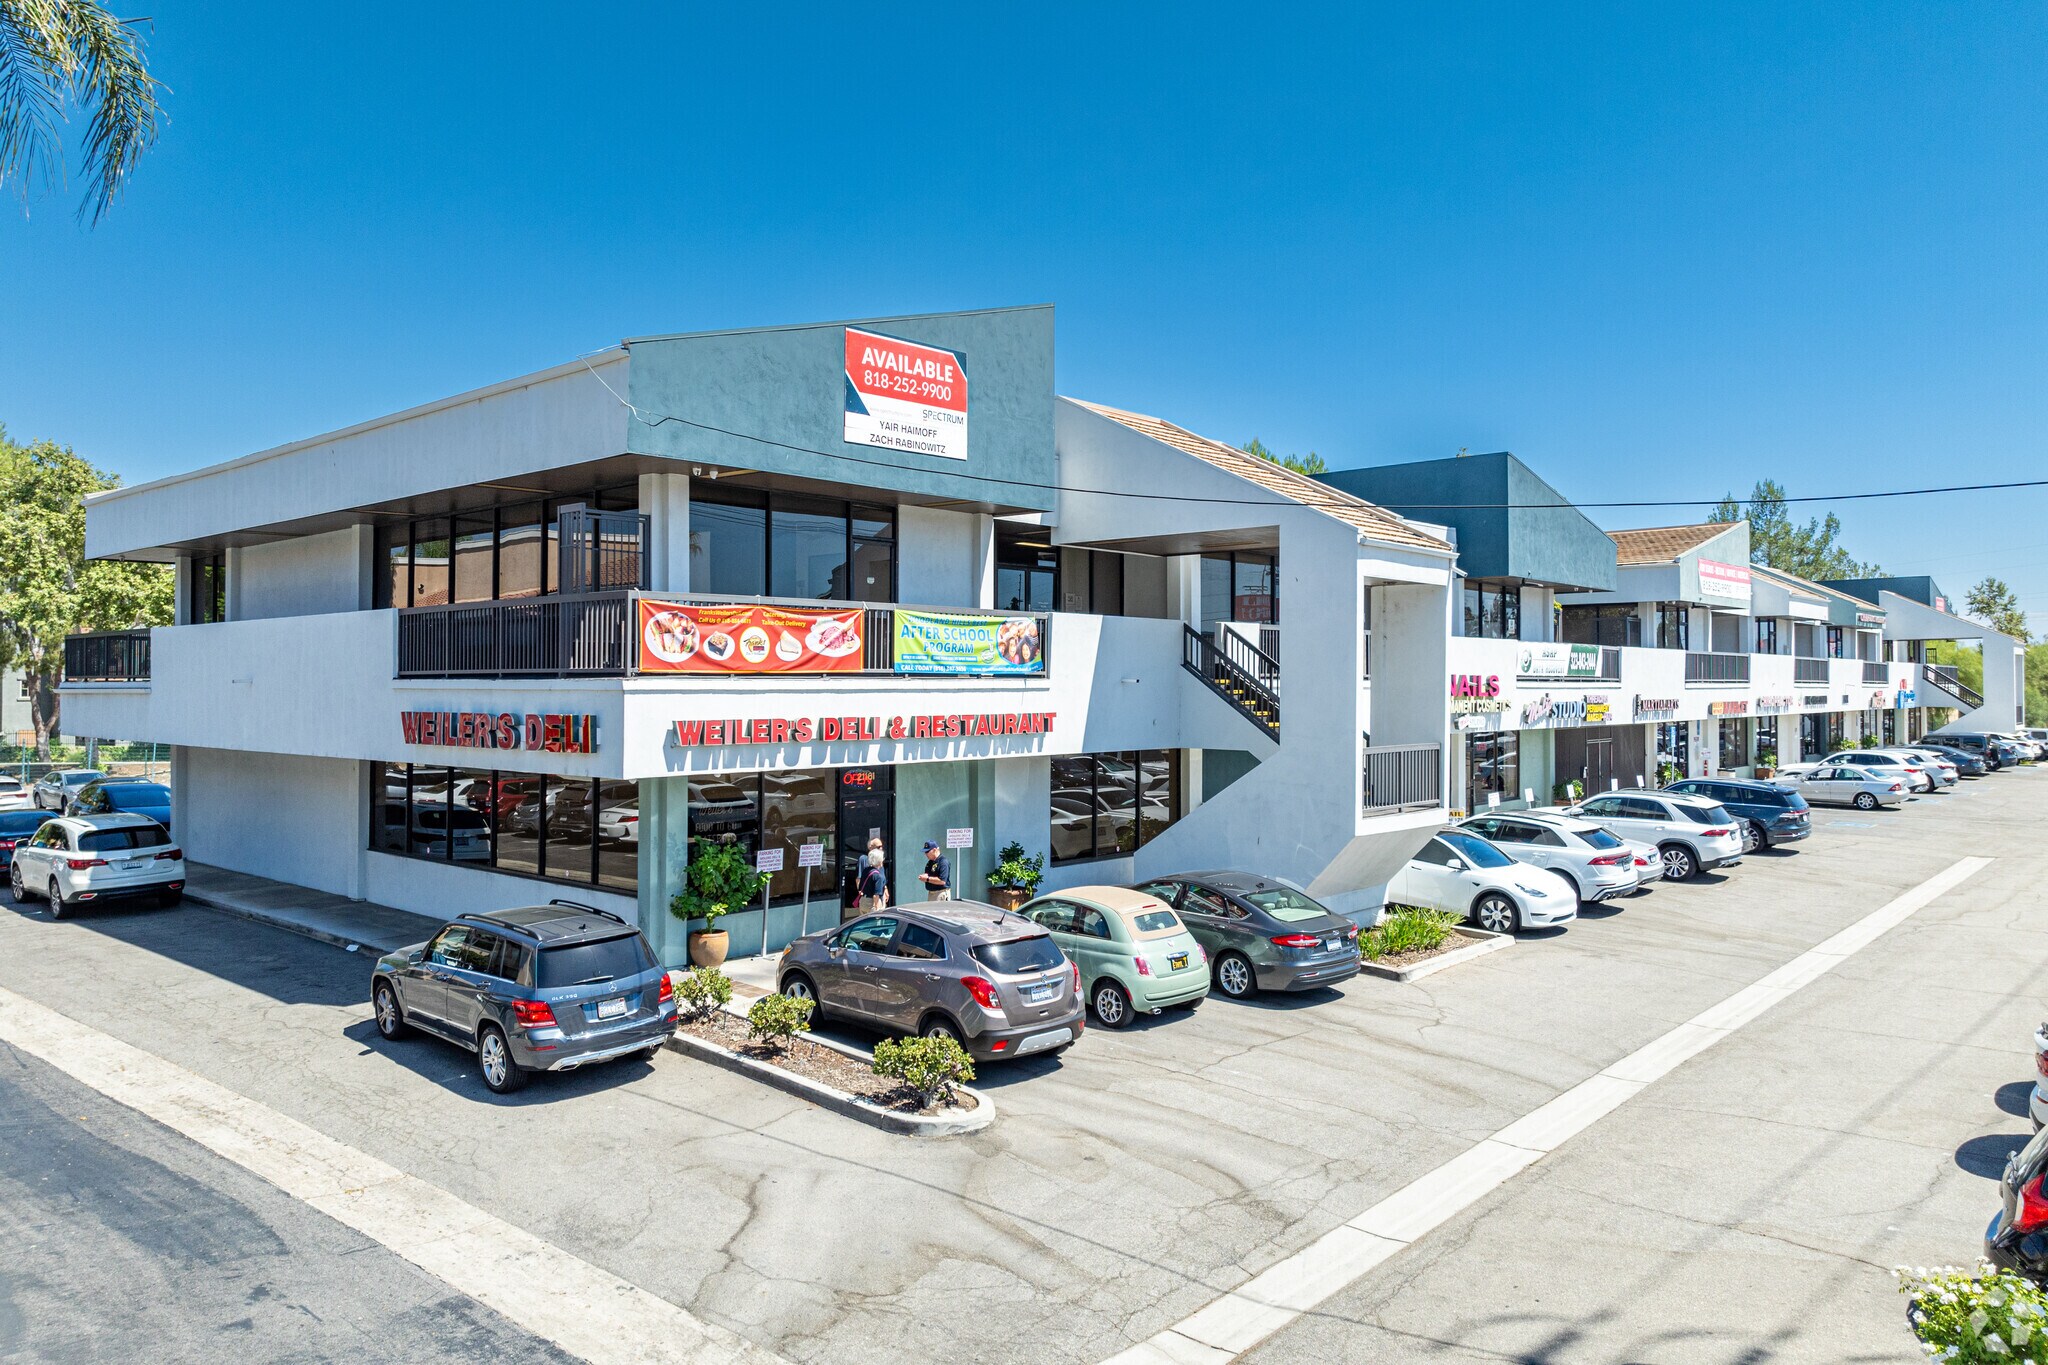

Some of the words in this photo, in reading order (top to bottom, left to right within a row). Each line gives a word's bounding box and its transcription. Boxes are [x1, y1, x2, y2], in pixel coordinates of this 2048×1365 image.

[861, 347, 953, 383] AVAILABLE
[864, 369, 951, 401] 818-252-9900
[923, 409, 963, 425] SPECTRUM
[880, 420, 898, 432] YAIR
[901, 424, 937, 438] HAIMOFF
[870, 433, 893, 445] ZACH
[896, 437, 945, 453] RABINOWITZ
[901, 624, 940, 640] AFTER
[944, 627, 993, 642] SCHOOL
[923, 641, 974, 654] PROGRAM
[1552, 700, 1587, 719] STUDIO
[401, 711, 518, 750] WEILER'S
[525, 713, 596, 753] DELI
[677, 716, 813, 747] WEILER'S
[824, 716, 881, 742] DELI
[889, 715, 907, 740] &
[914, 712, 1057, 738] RESTAURANT
